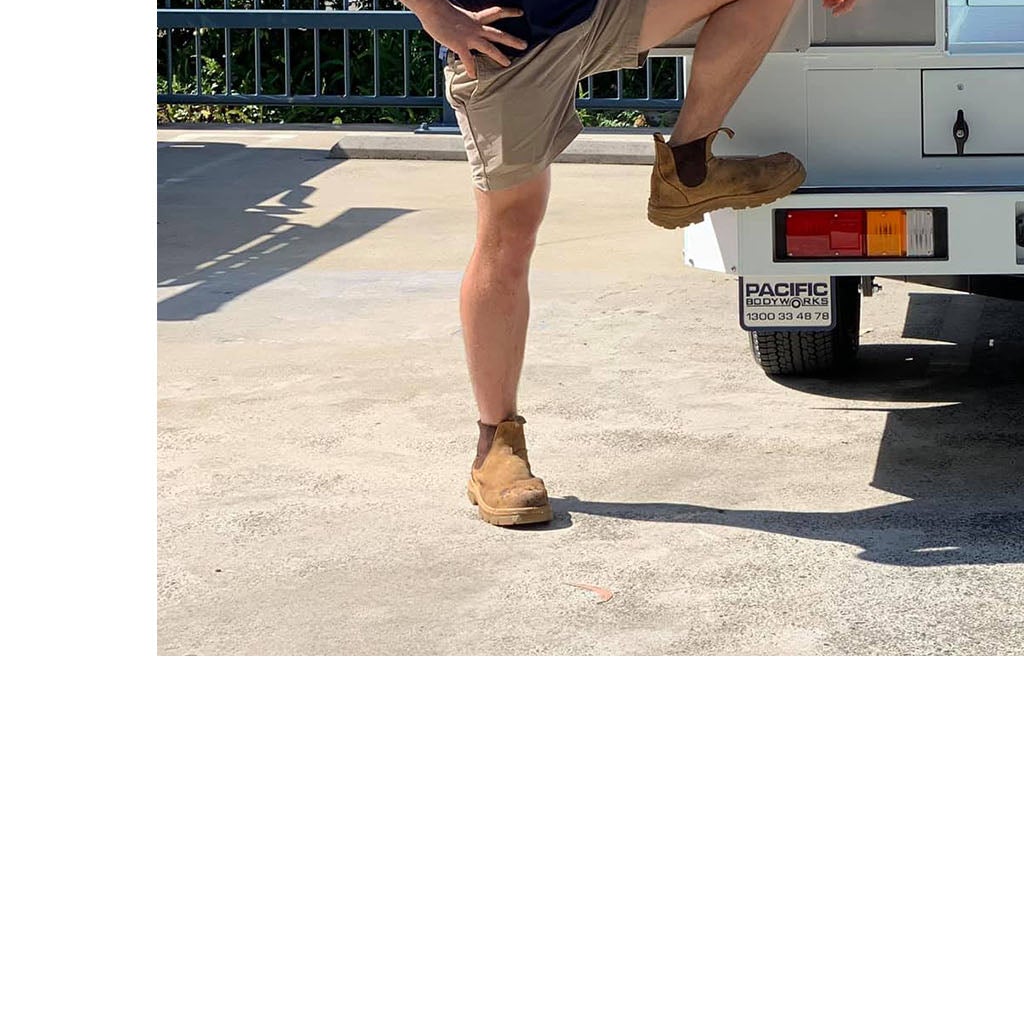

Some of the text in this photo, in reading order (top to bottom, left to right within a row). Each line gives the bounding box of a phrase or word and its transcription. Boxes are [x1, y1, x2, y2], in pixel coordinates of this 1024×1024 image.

[746, 282, 829, 297] PACIFIC
[746, 297, 829, 308] BODYWORKS
[746, 311, 830, 321] 1300 33 48 78
